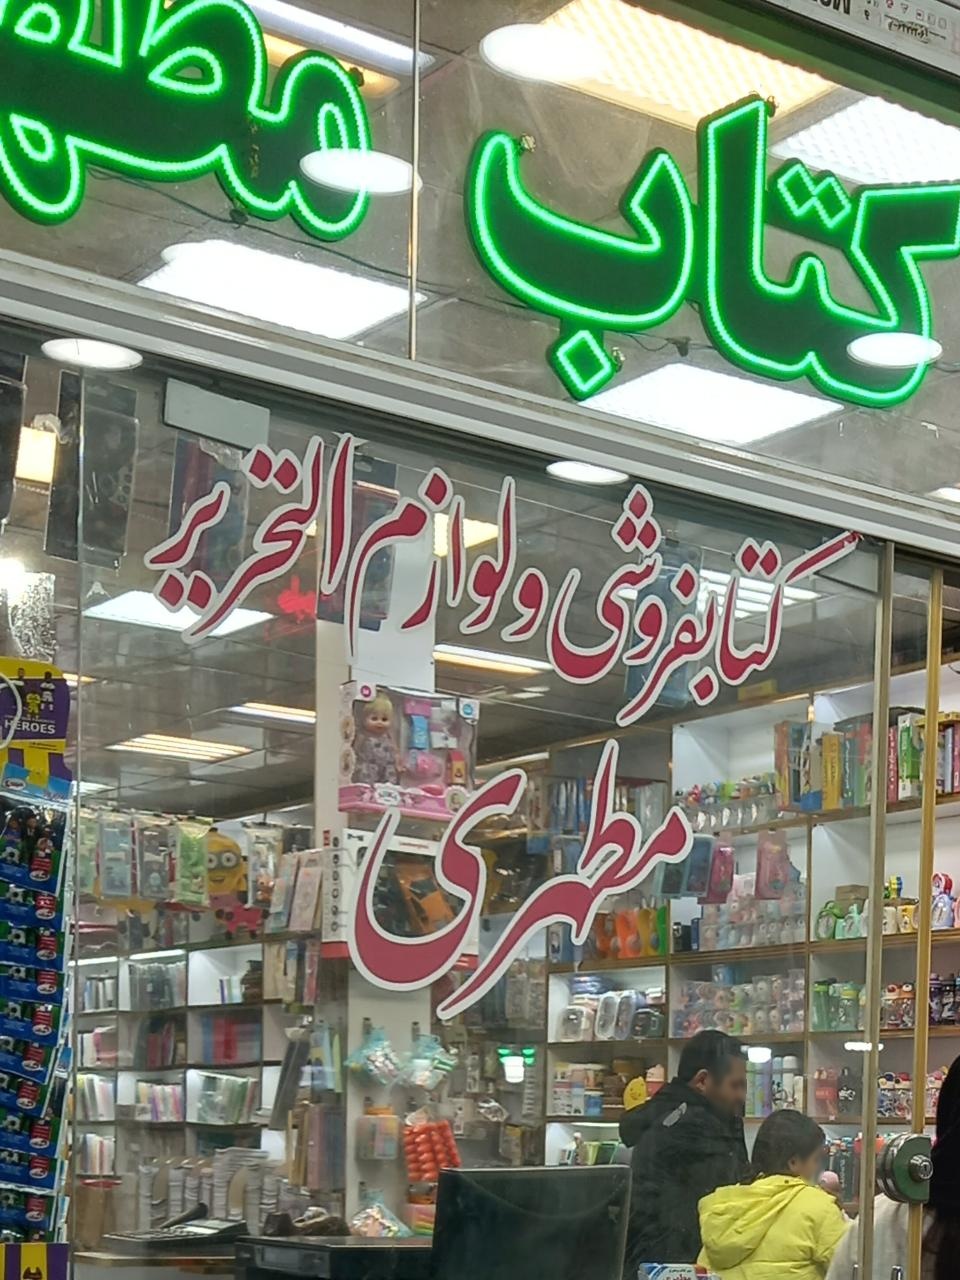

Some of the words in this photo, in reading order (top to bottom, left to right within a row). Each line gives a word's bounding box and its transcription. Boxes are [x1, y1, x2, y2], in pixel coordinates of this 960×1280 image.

[0, 0, 370, 242] مطه
[145, 432, 354, 645] التحریر
[545, 483, 864, 728] کتابفروشی
[4, 720, 56, 735] HEROES
[348, 738, 694, 1021] مطهری
